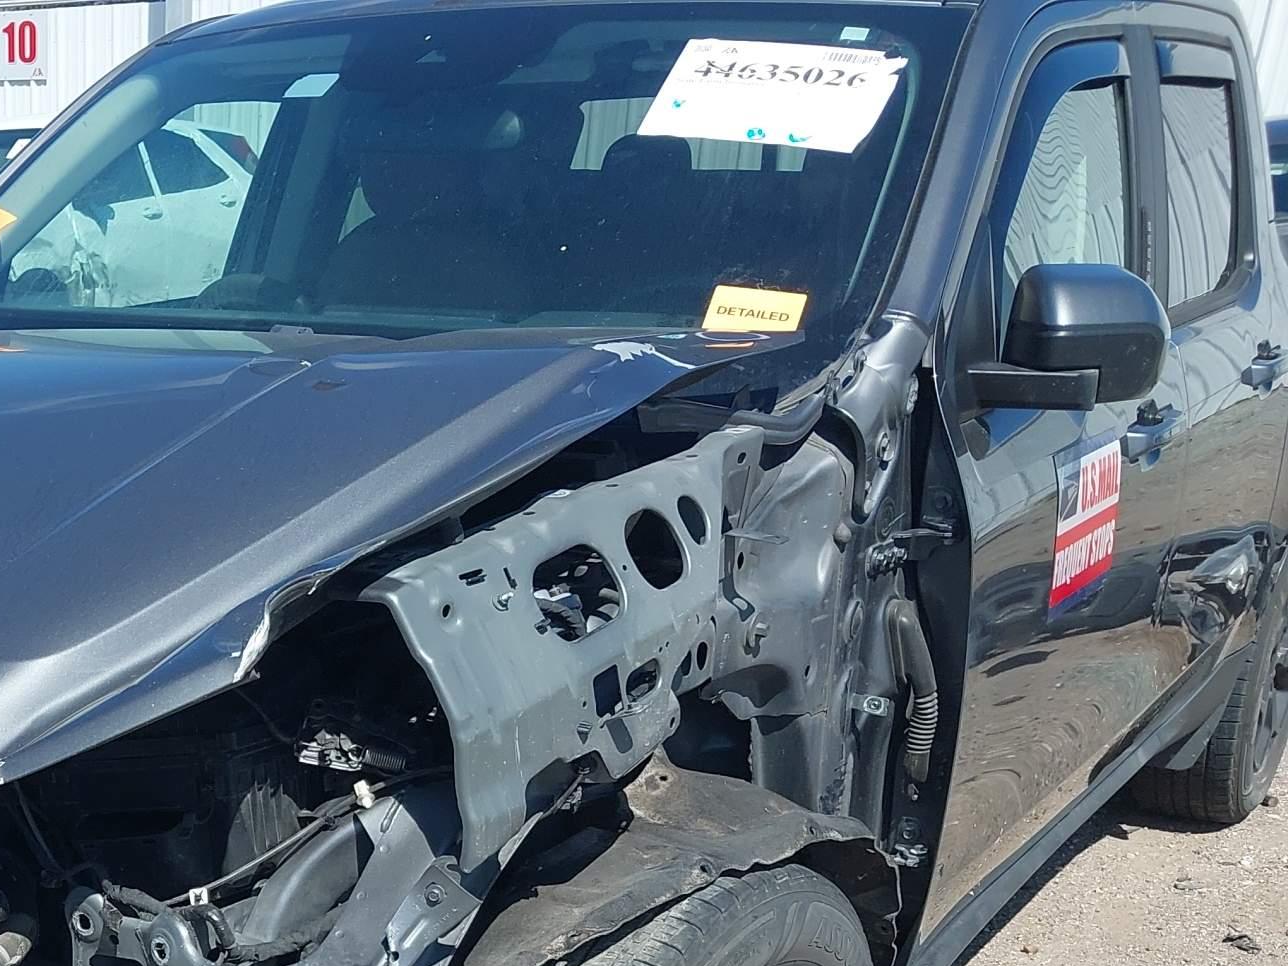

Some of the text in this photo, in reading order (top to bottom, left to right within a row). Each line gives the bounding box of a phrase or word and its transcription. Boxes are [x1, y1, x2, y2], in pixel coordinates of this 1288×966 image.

[1, 19, 37, 64] 10
[693, 59, 869, 89] 44635026
[716, 305, 790, 322] DETAILED
[1052, 519, 1116, 591] FREQUENT STOPS
